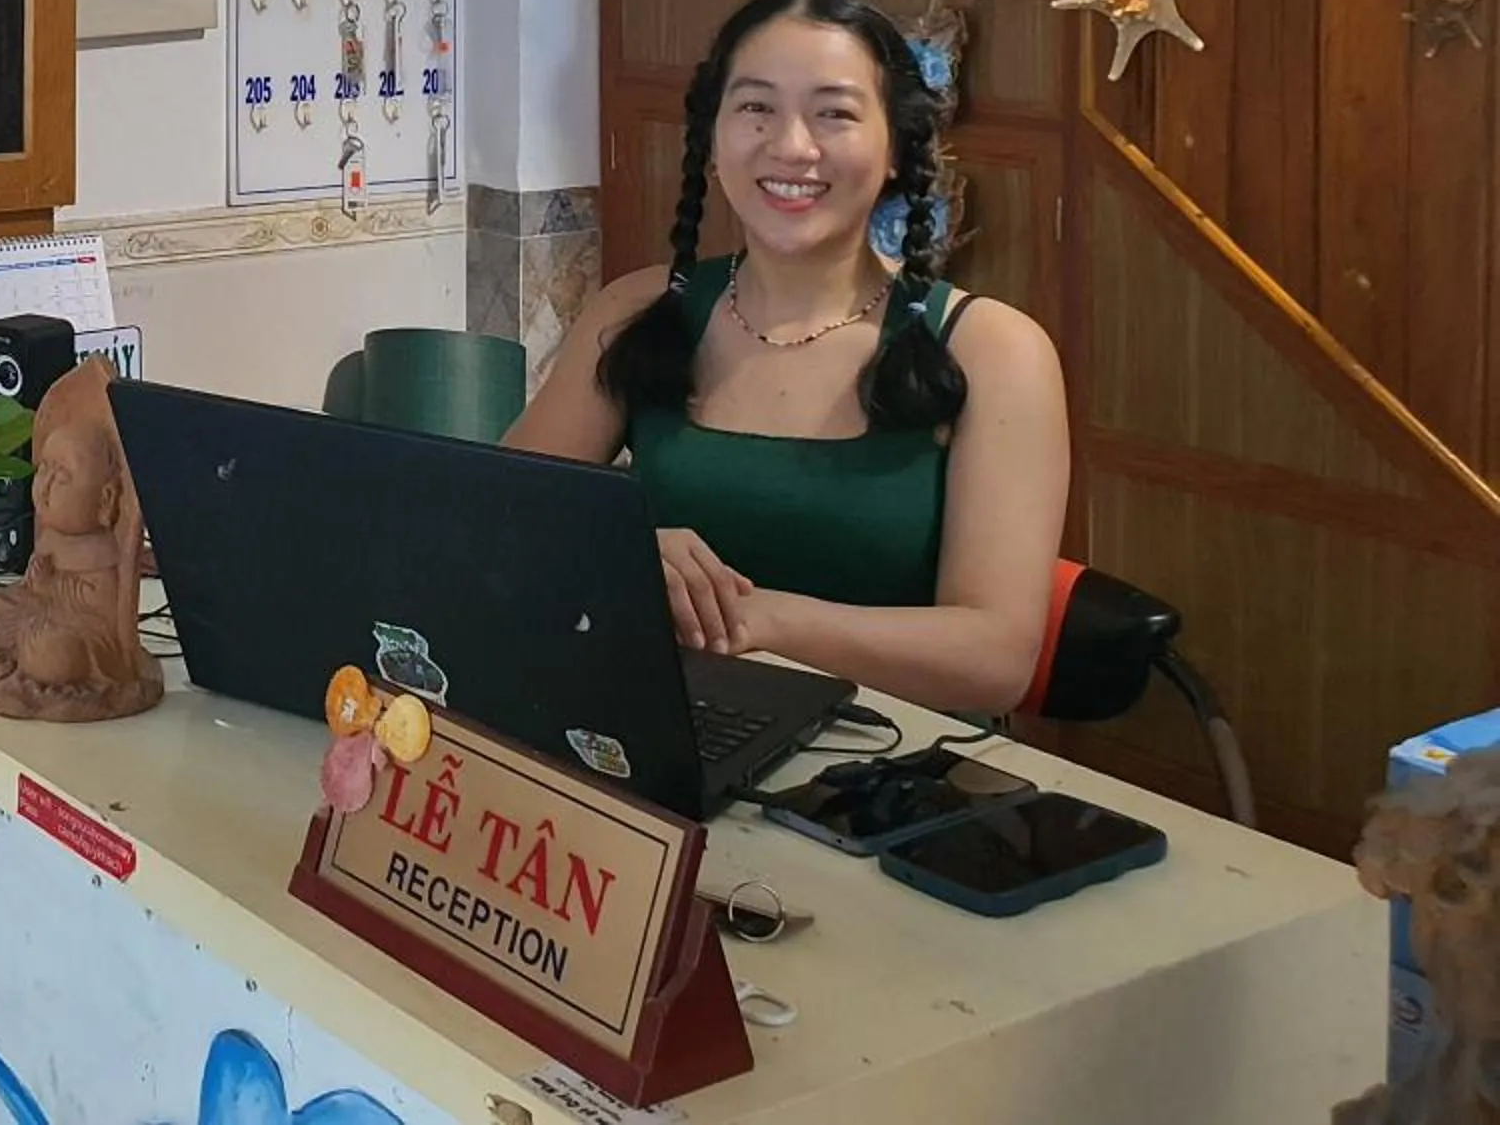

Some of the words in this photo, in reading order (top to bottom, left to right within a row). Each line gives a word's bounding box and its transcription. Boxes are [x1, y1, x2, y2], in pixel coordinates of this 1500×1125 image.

[245, 77, 273, 104] 205
[289, 74, 316, 102] 204
[379, 71, 405, 97] 20
[378, 752, 464, 856] LỄ
[477, 818, 617, 937] TÂN
[384, 849, 570, 984] RECEPTION
